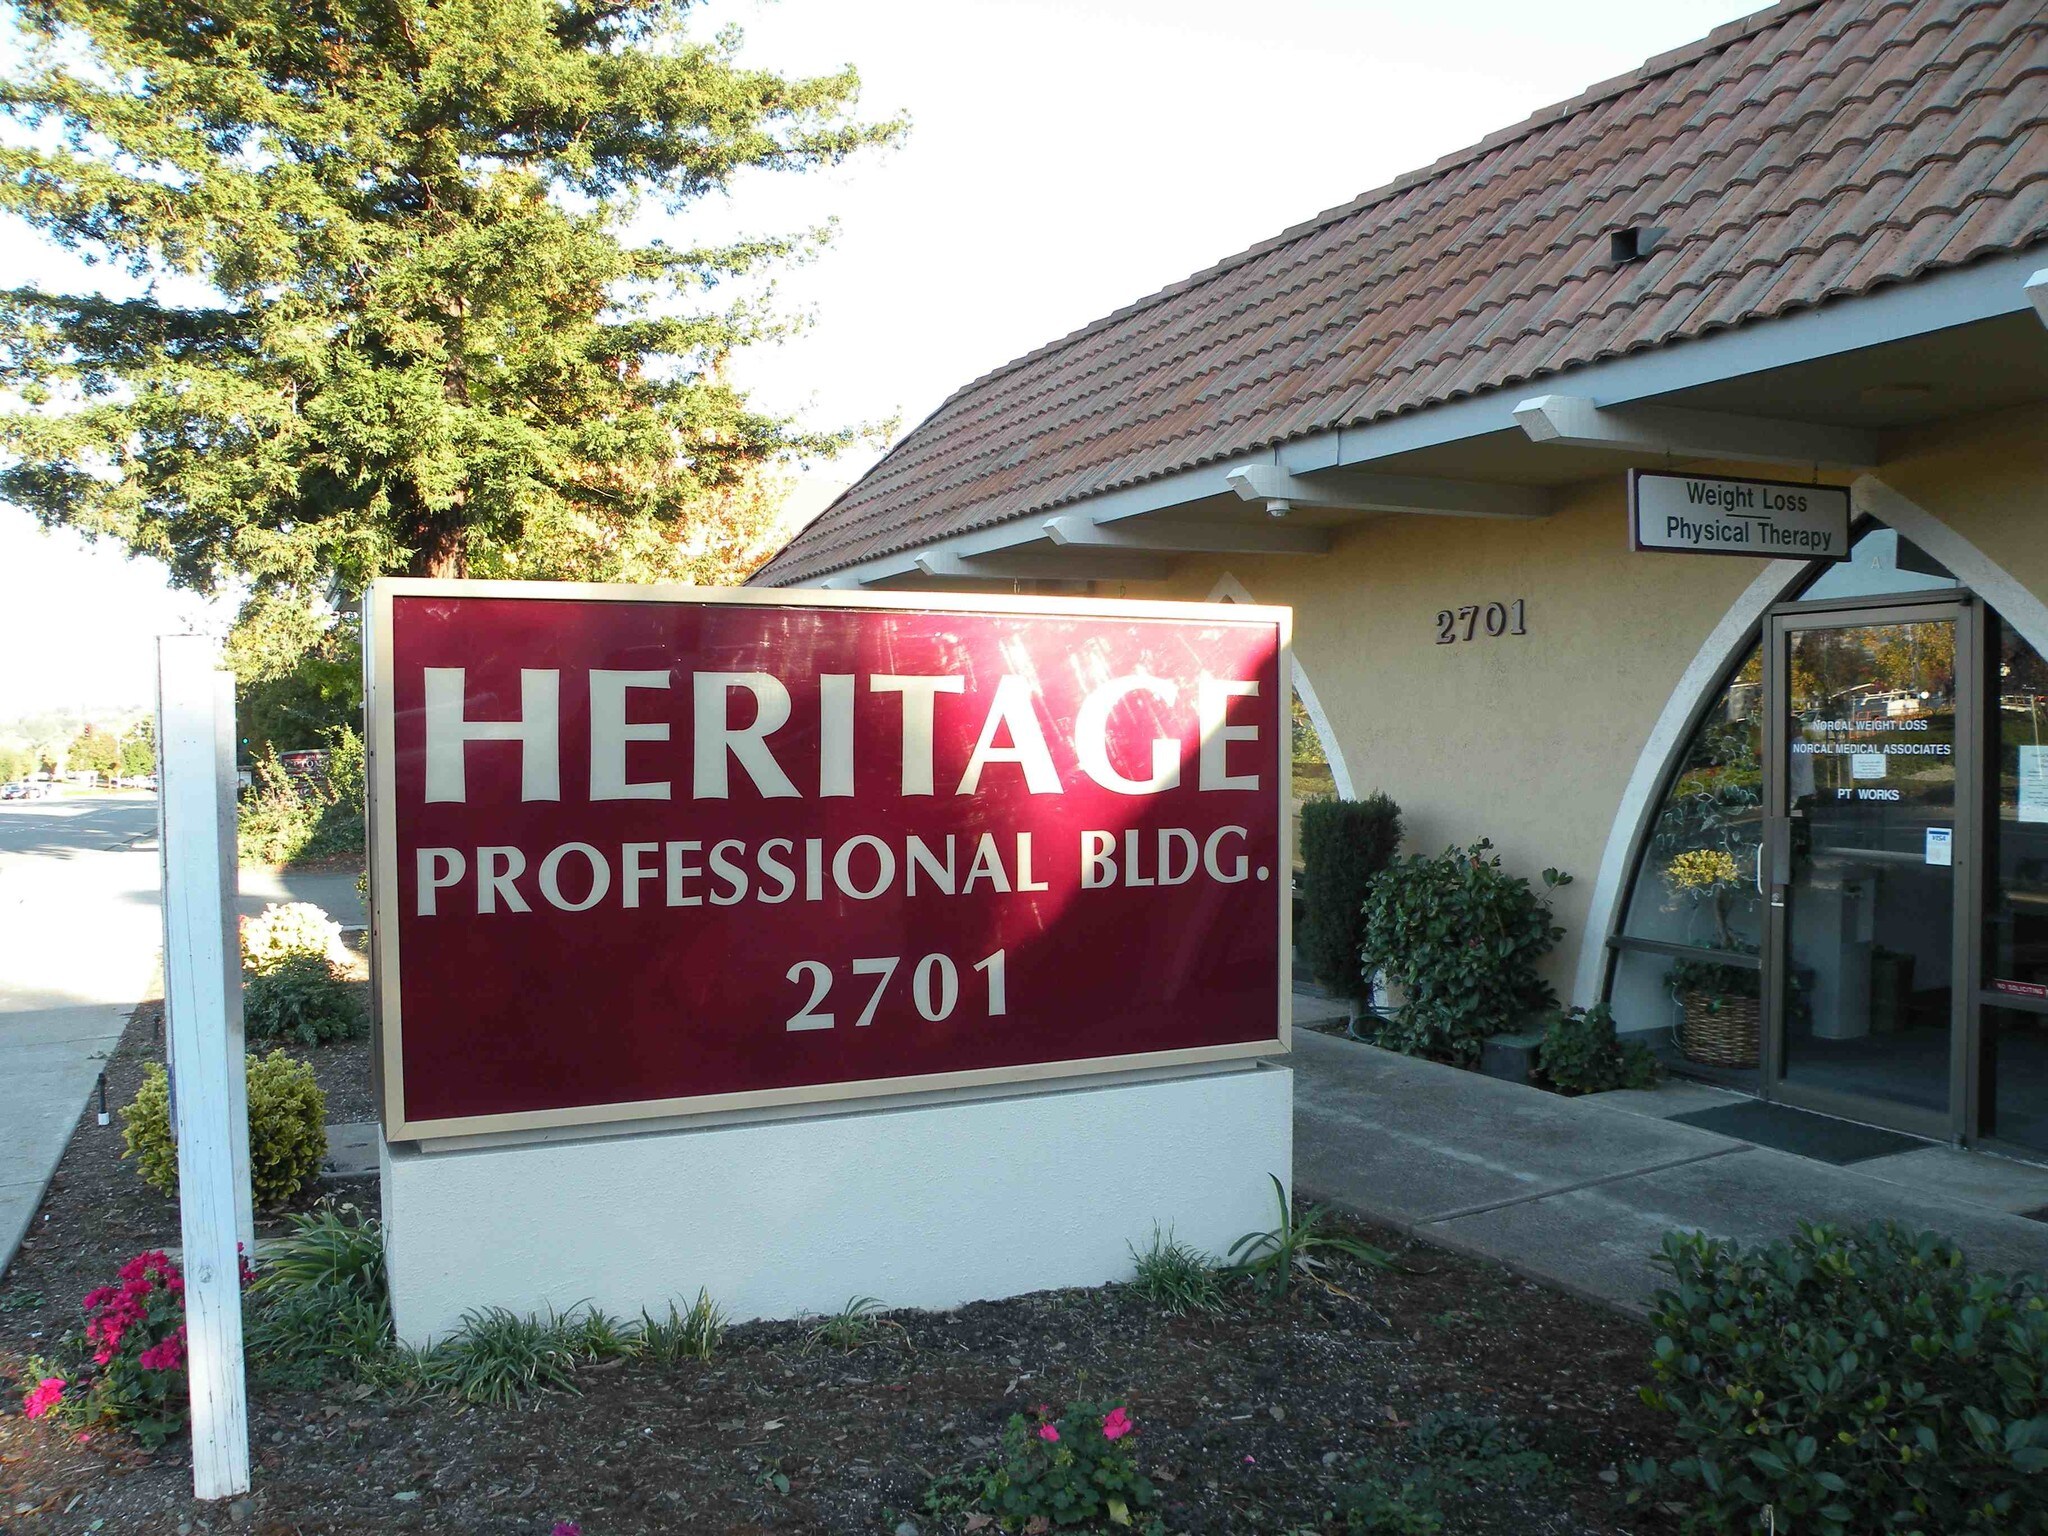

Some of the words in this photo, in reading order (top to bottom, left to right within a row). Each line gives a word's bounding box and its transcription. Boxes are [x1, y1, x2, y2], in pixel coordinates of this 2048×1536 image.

[1686, 481, 1755, 513] Weight
[1762, 487, 1808, 513] Loss
[1666, 515, 1750, 544] Physical
[1757, 521, 1833, 552] Therapy
[1434, 598, 1528, 645] 2701
[423, 666, 1260, 804] HERITAGE
[1812, 719, 1854, 732] NORCAL
[1855, 720, 1897, 732] WEIGHT
[1898, 719, 1928, 732] LOSS
[1792, 743, 1833, 754] NORCAL
[1835, 743, 1880, 755] MEDICAL
[1883, 744, 1951, 755] ASSOCIATES
[1837, 788, 1853, 800] PT
[1858, 788, 1900, 801] WORKS
[416, 830, 1049, 917] PROFESSIONAL
[1080, 825, 1270, 890] BLDG.
[785, 948, 1008, 1032] 2701
